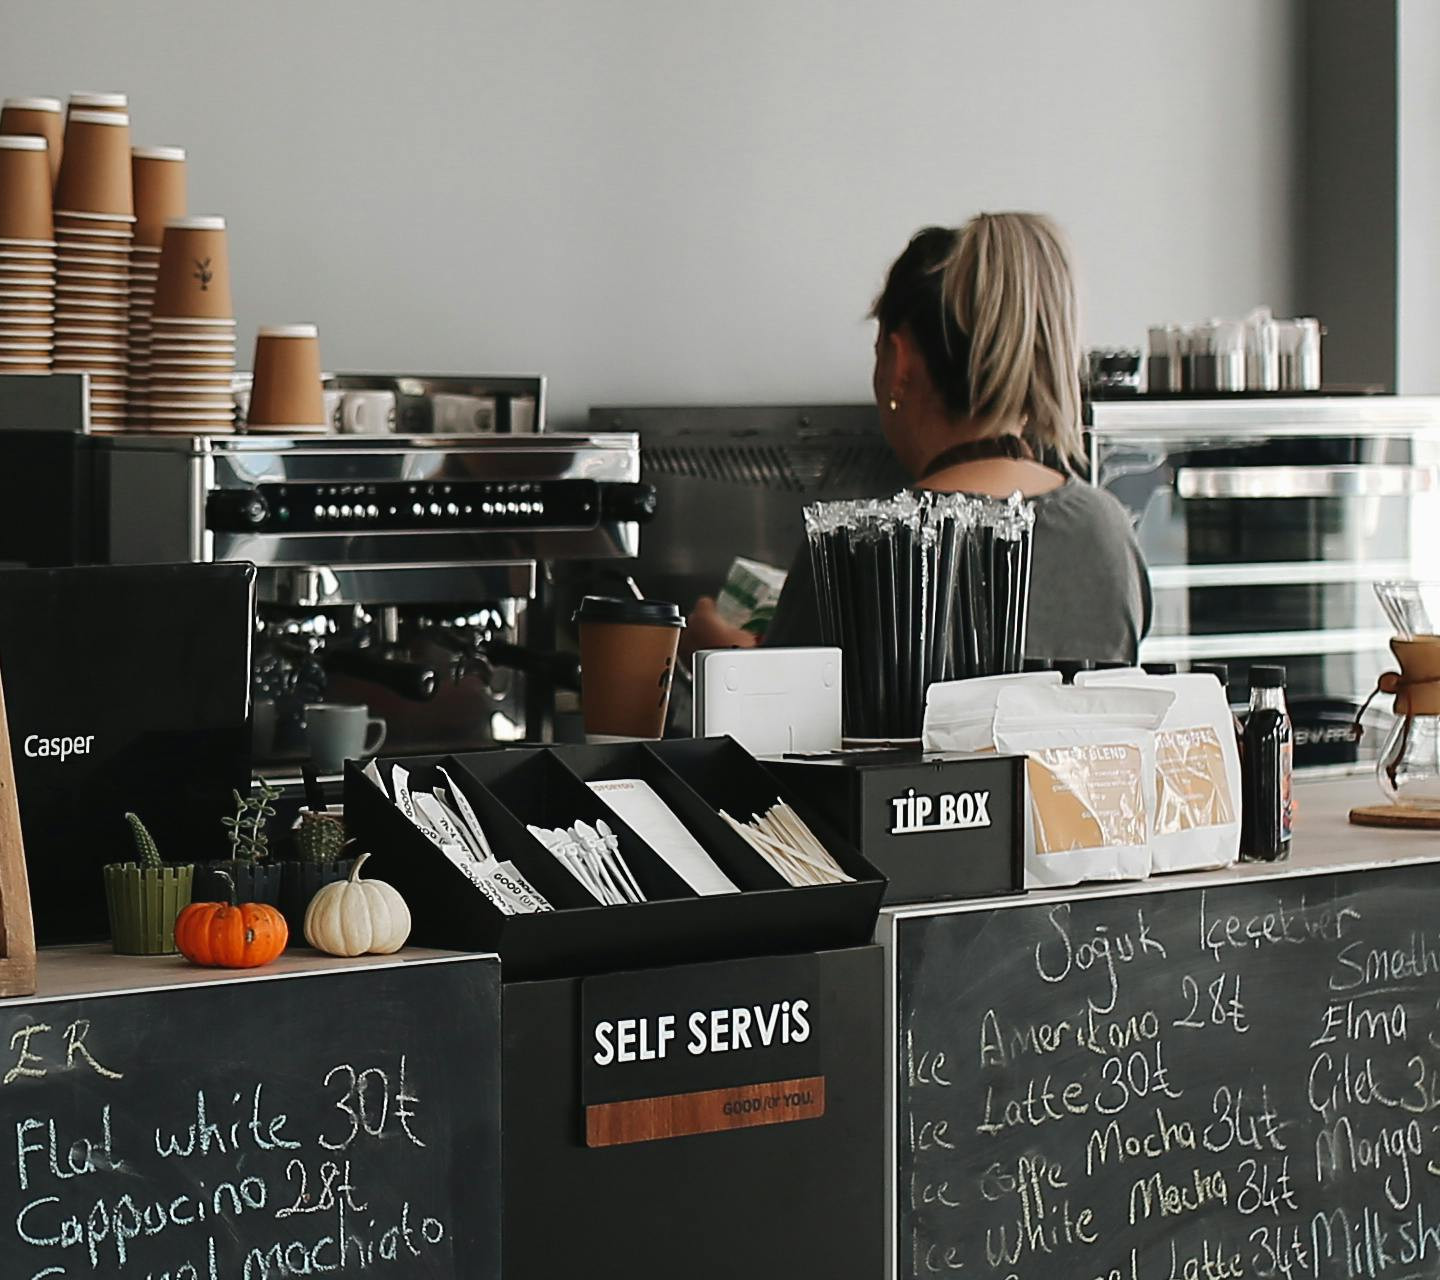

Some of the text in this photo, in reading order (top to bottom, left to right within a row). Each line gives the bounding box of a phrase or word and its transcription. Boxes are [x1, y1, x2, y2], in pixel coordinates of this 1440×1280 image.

[24, 734, 95, 762] Casper
[1089, 747, 1127, 761] BLEND
[939, 790, 991, 827] BOX
[493, 871, 522, 896] GOOD
[593, 1014, 676, 1067] SELF
[1308, 1000, 1408, 1049] Elma
[722, 1091, 815, 1117] GOOD for YOU.
[976, 1075, 1090, 1136] Latte
[15, 1104, 123, 1190] Flat
[1086, 1108, 1197, 1176] Mocha
[1316, 1116, 1422, 1210] Mango
[15, 1175, 268, 1270] Cappucino
[1128, 1169, 1228, 1225] Mocha
